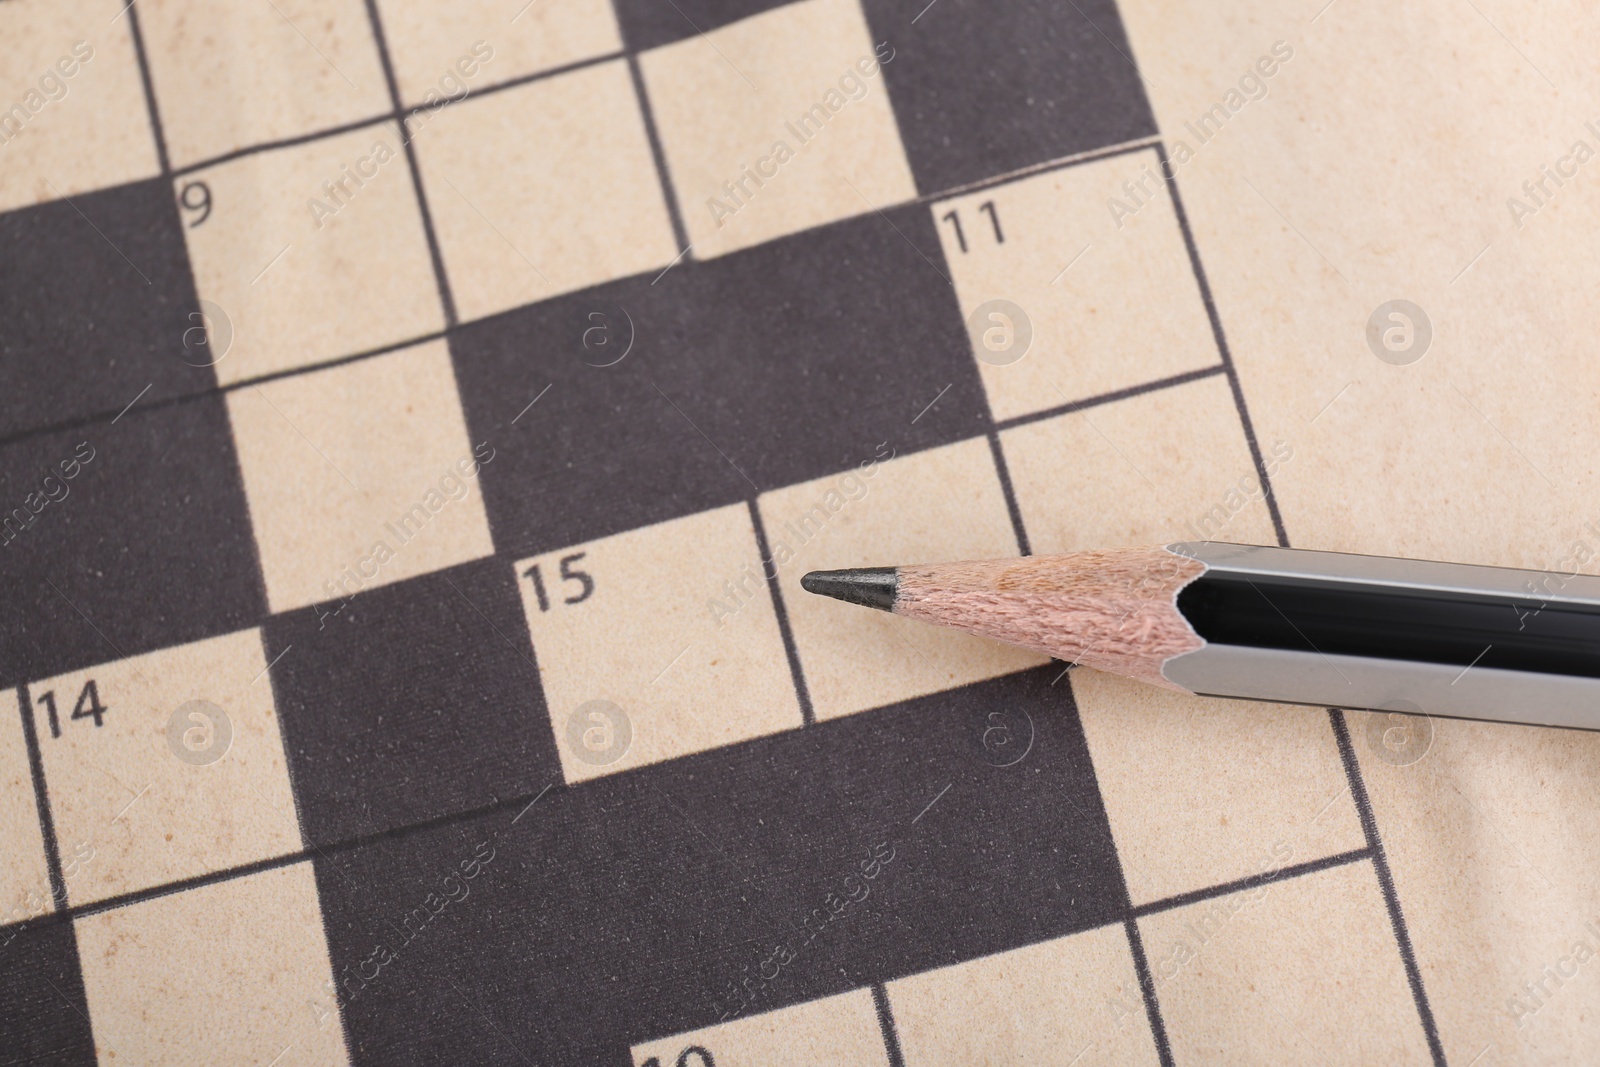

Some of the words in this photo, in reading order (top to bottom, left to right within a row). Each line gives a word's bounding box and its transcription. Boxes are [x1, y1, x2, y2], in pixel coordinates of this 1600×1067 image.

[180, 181, 212, 228] 9
[943, 200, 1004, 253] 11
[523, 552, 594, 612] 15
[37, 679, 107, 739] 14
